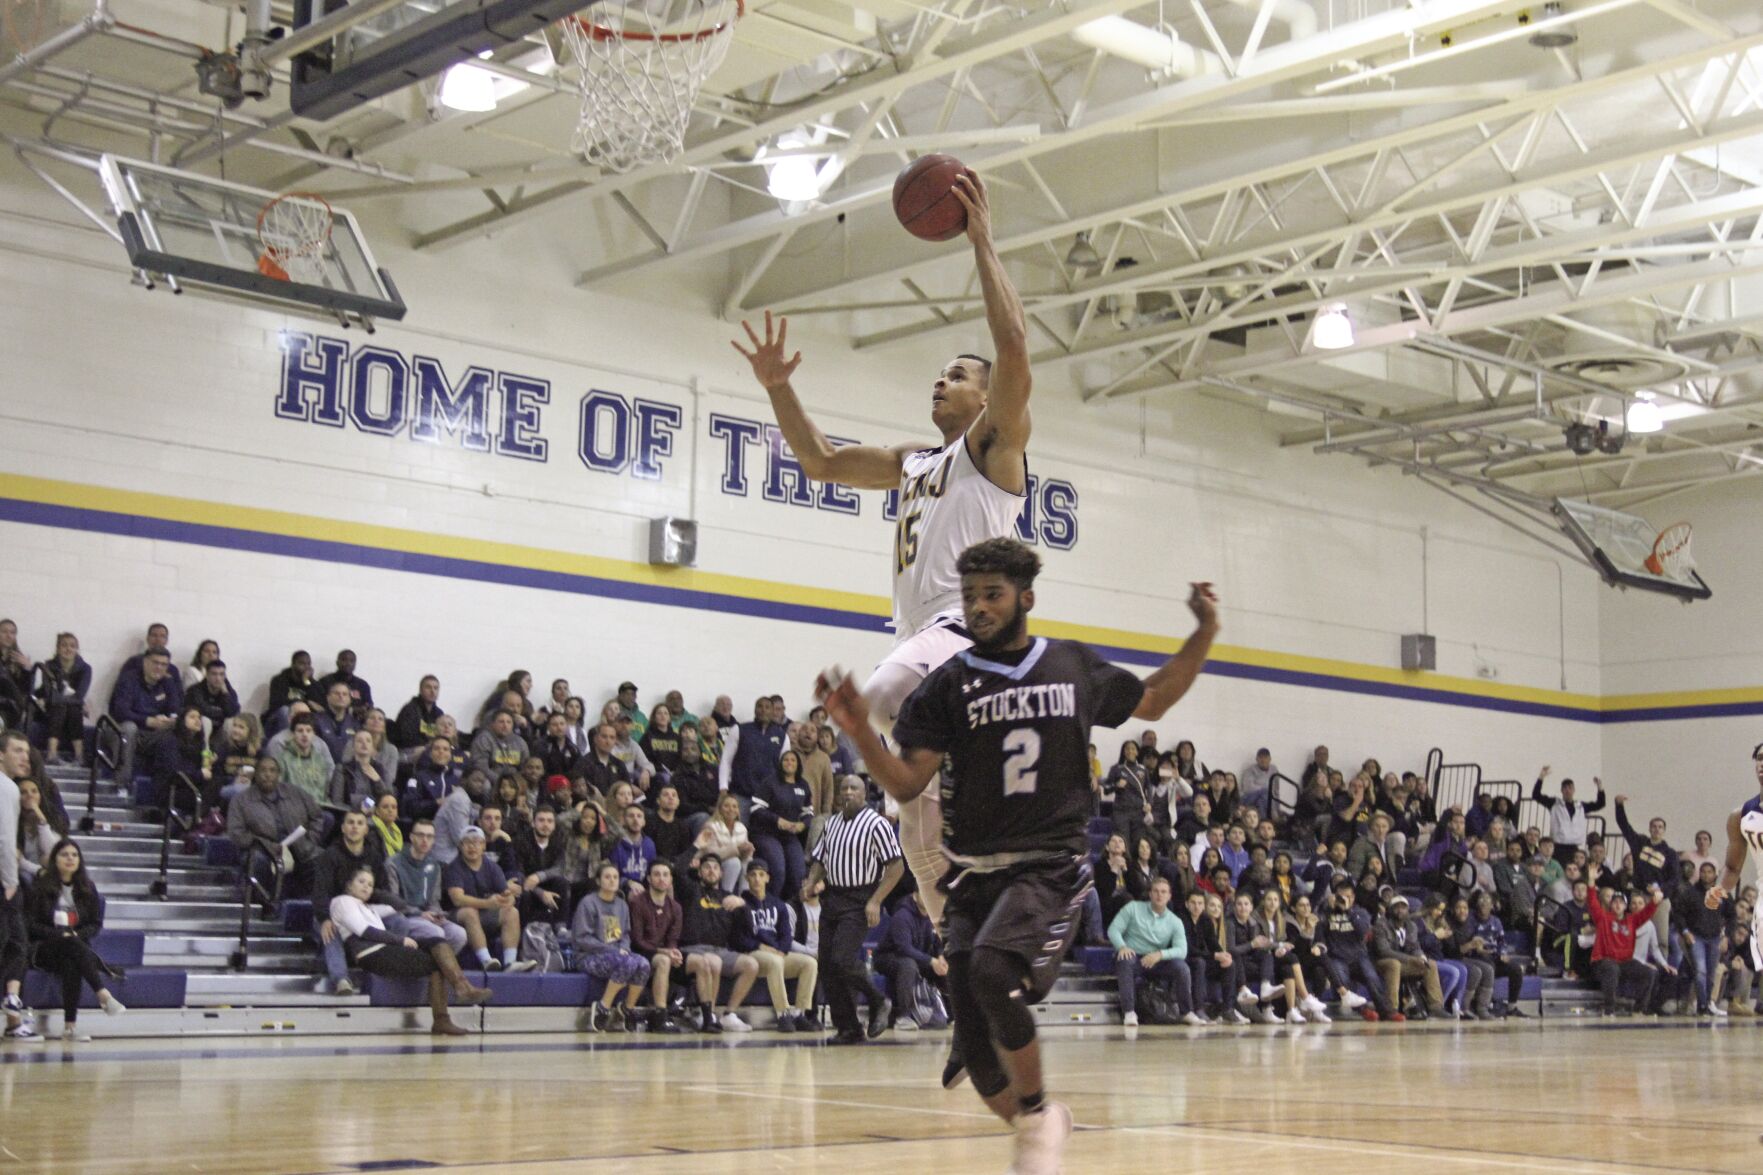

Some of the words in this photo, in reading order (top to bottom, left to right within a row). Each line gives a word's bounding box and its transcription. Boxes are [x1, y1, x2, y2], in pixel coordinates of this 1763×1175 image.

[274, 330, 551, 463] HOME
[578, 389, 682, 481] OF
[967, 683, 1075, 729] STOCKTON
[1002, 728, 1041, 797] 2
